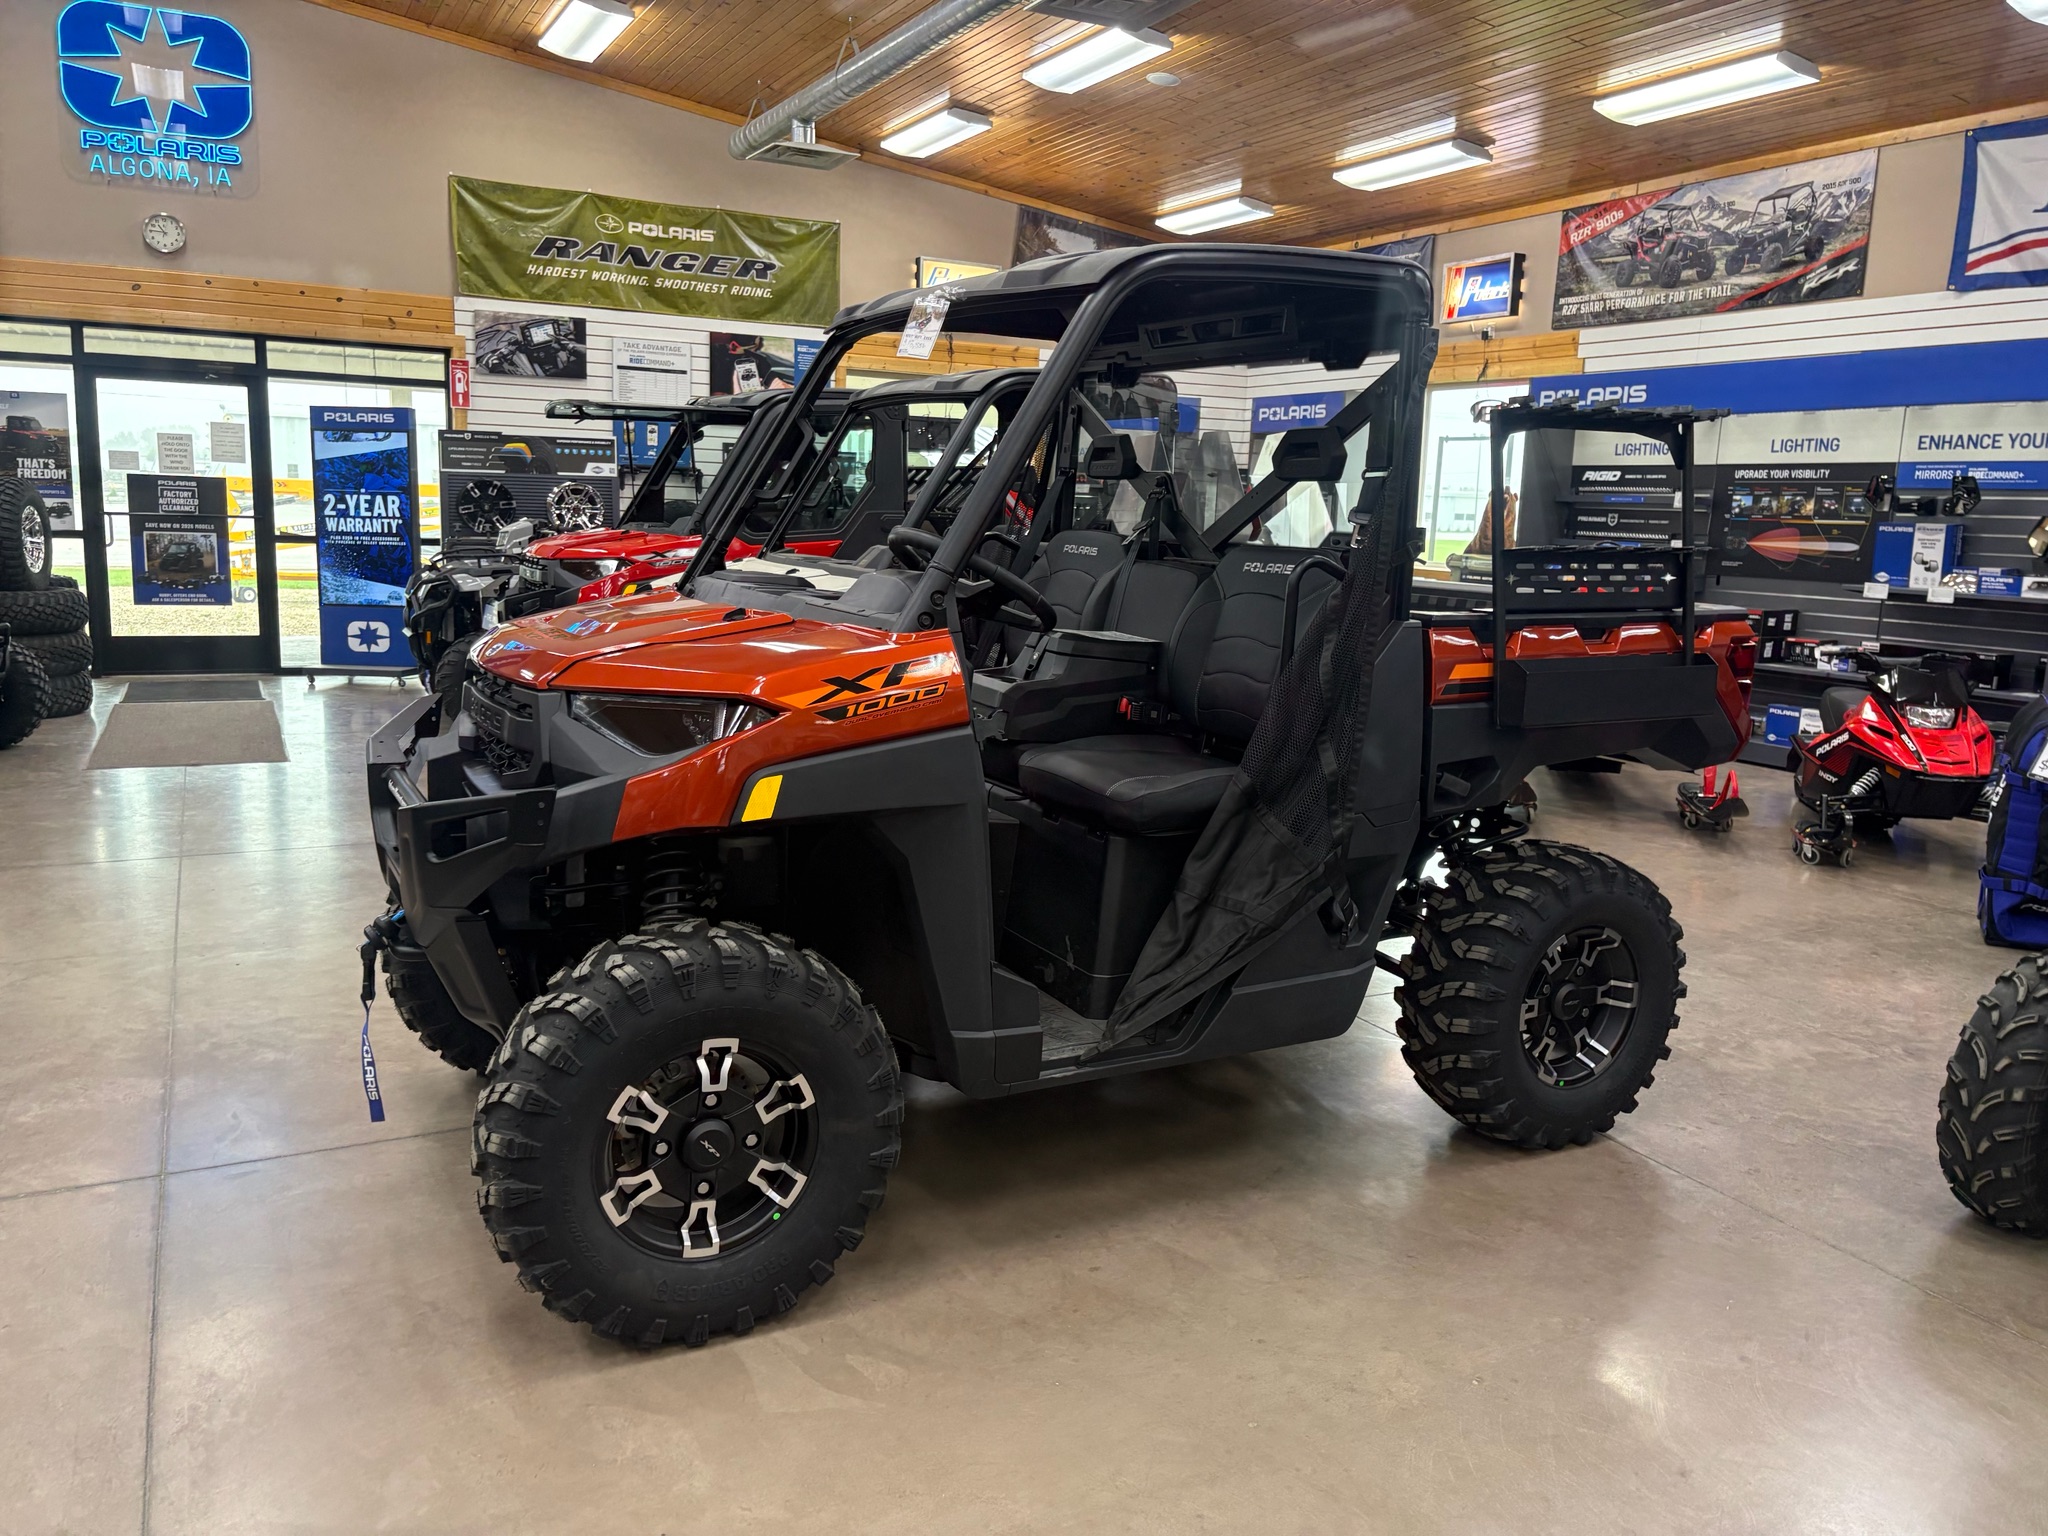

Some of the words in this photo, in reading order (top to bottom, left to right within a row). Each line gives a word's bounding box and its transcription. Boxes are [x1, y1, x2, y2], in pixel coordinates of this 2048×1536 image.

[80, 129, 242, 165] POLARIS
[90, 154, 199, 187] ALGONA,
[208, 165, 232, 187] IA
[628, 221, 715, 242] POLARIS
[531, 235, 778, 282] RANGER
[526, 264, 588, 280] HARDEST
[591, 270, 649, 287] WORKING.
[654, 277, 728, 294] SMOOTHEST
[731, 285, 773, 299] RIDING.
[1580, 302, 1604, 314] SHARP
[1606, 293, 1666, 312] PERFORMANCE
[1668, 291, 1685, 303] FOR
[1688, 289, 1704, 301] THE
[1705, 284, 1732, 299] TRAIL
[1590, 293, 1603, 301] NEXT
[1603, 289, 1636, 300] GENERATION
[1636, 288, 1644, 296] OF
[642, 343, 682, 353] ADVANTAGE
[323, 412, 395, 423] POLARIS
[1258, 404, 1327, 421] POLARIS
[1770, 437, 1841, 454] LIGHTING
[1917, 433, 2004, 451] ENHANCE
[2008, 432, 2048, 449] YOU
[1615, 443, 1670, 456] LIGHTING
[16, 457, 55, 469] THAT'S
[17, 468, 67, 480] FREEDOM
[1582, 470, 1622, 481] RIGID
[1734, 469, 1769, 479] UPGRADE
[1769, 469, 1790, 479] YOUR
[1790, 469, 1830, 479] VISIBILITY
[1914, 469, 1954, 480] MIRRORS
[163, 490, 193, 498] FACTORY
[162, 504, 196, 512] CLEARANCE
[323, 493, 401, 517] 2-YEAR
[1879, 525, 1913, 533] POLARIS
[1063, 544, 1098, 556] POLARIS
[1242, 562, 1295, 575] POLARIS
[806, 652, 949, 706] XP
[845, 683, 947, 718] 1000
[844, 715, 870, 726] DUAL
[871, 704, 922, 720] OVERHEAD
[922, 698, 943, 707] CAM
[1769, 708, 1800, 718] POLARIS
[1816, 731, 1849, 757] POLARIS
[1900, 733, 1916, 751] 200
[1818, 769, 1839, 783] INDY
[700, 1139, 720, 1158] XP
